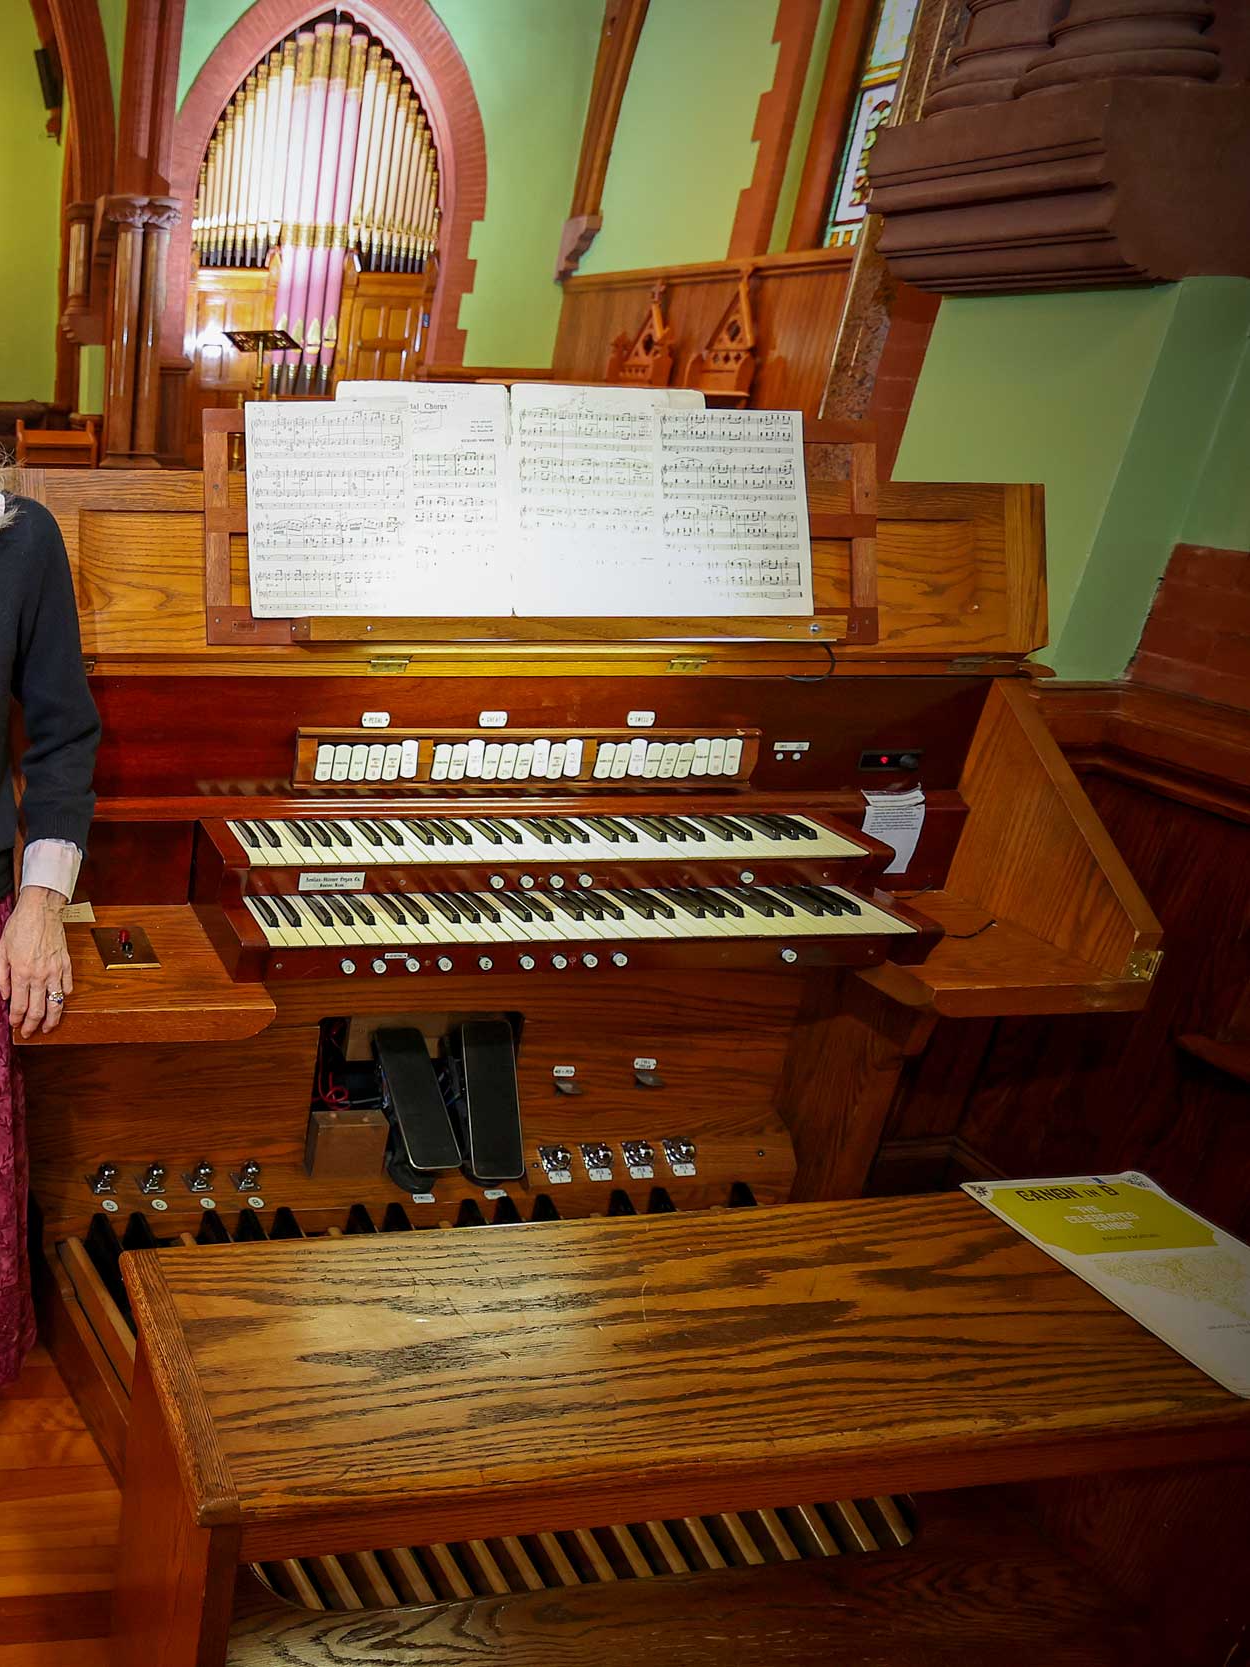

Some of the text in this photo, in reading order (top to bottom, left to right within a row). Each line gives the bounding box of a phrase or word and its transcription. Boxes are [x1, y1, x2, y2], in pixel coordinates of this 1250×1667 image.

[424, 402, 448, 410] Chorus
[1015, 1185, 1120, 1202] CANON IN D
